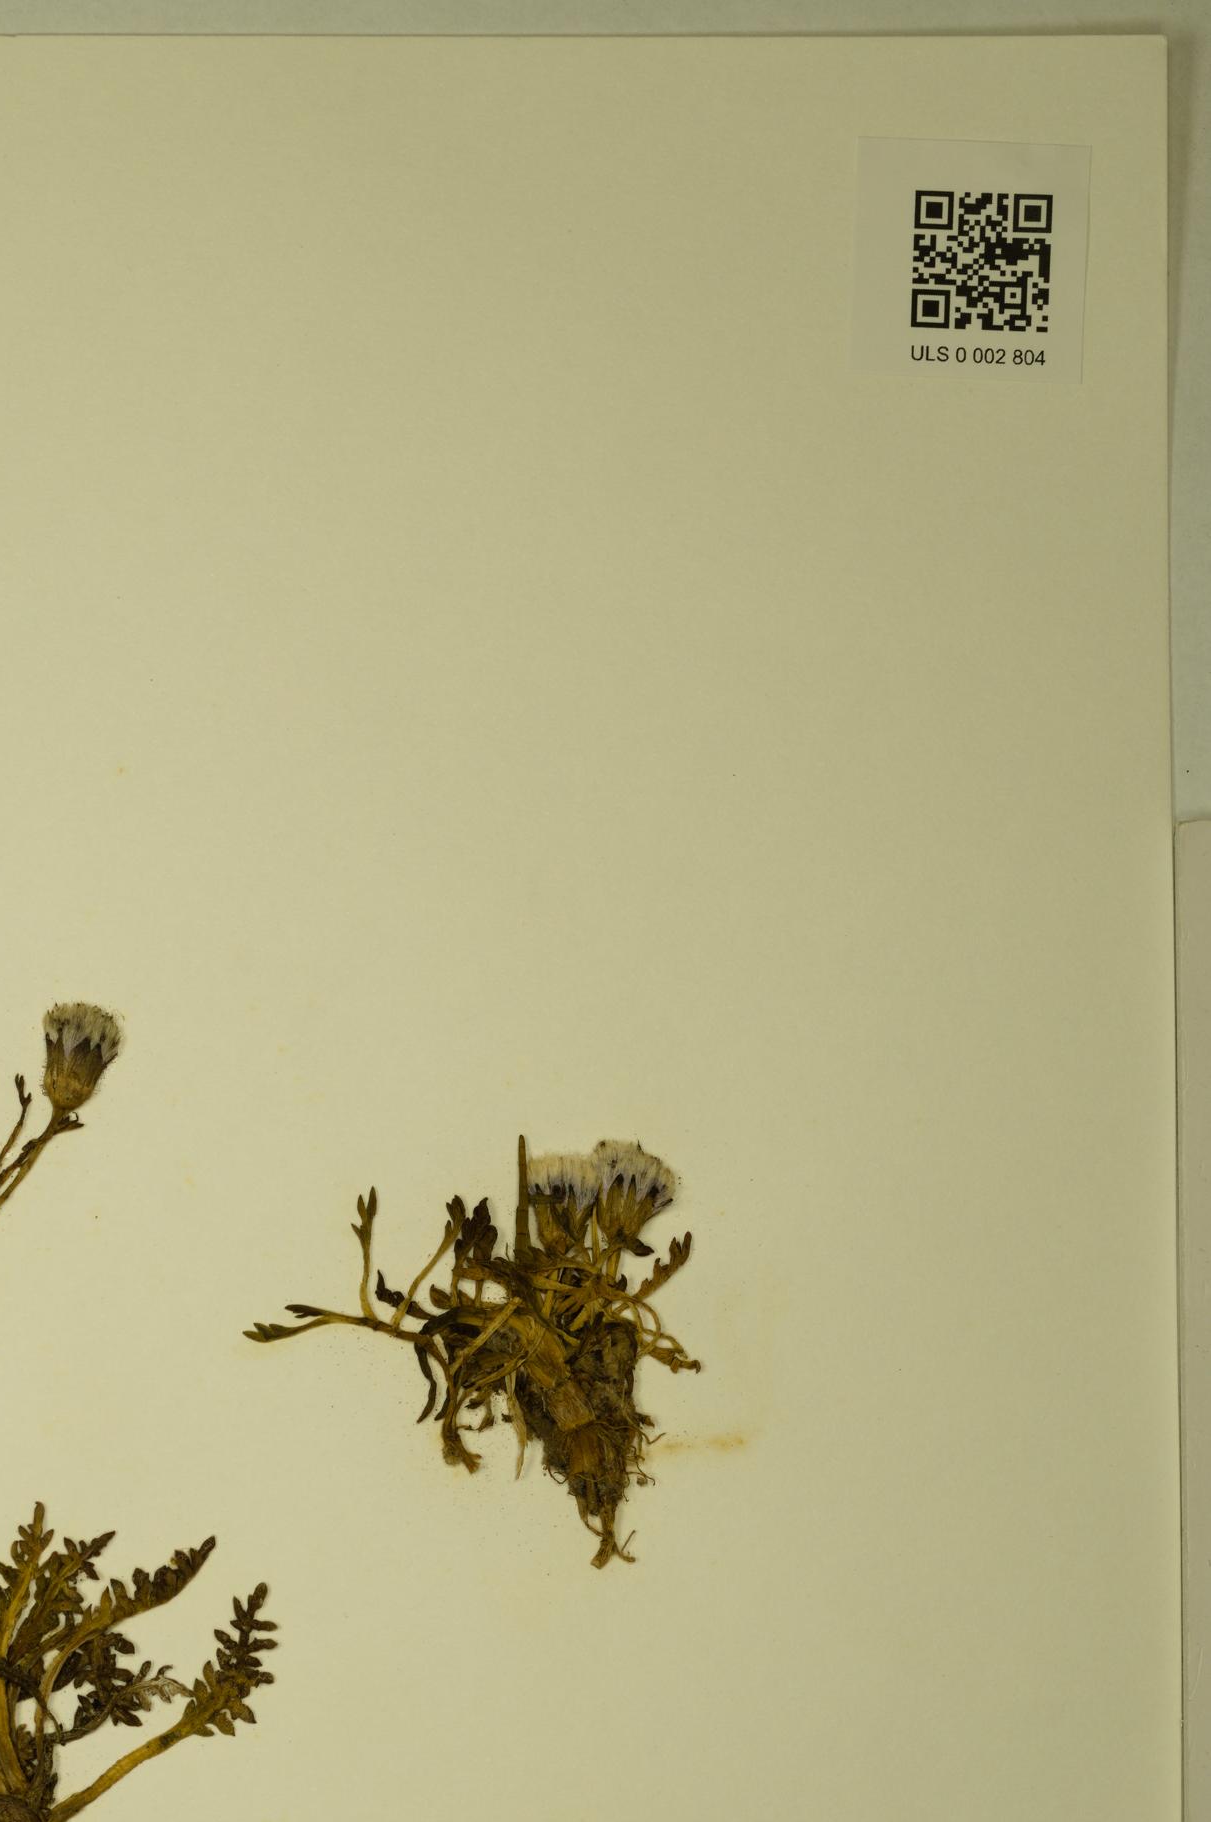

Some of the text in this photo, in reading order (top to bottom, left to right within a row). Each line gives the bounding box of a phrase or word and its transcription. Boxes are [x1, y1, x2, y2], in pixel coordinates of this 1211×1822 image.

[910, 345, 1046, 366] ULS 0 002 804
